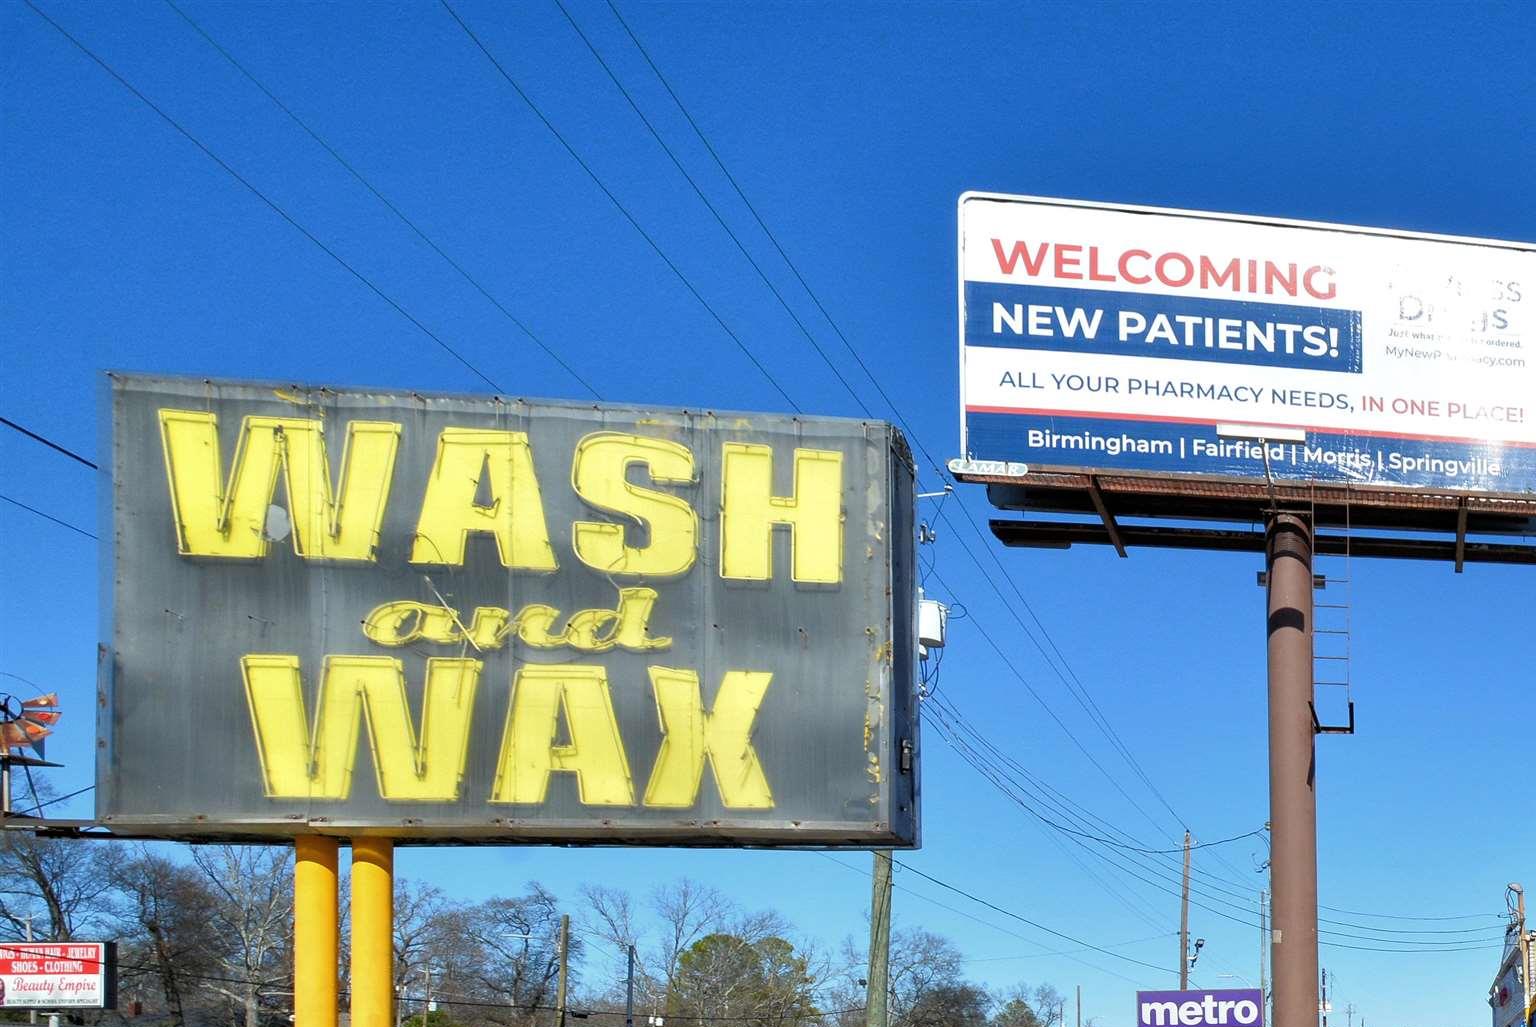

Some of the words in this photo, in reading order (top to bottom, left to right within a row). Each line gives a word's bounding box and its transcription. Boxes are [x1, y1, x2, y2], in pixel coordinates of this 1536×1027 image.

[991, 238, 1337, 300] WELCOMING
[992, 302, 1103, 339] NEW
[1119, 311, 1339, 358] PATIENTS!
[1000, 371, 1044, 389] ALL
[1051, 374, 1119, 394] YOUR
[1128, 378, 1264, 403] PHARMACY
[1271, 388, 1354, 413] NEEDS,
[1361, 395, 1385, 412] IN
[1392, 398, 1440, 417] ONE
[1448, 402, 1525, 423] PLACE!
[1028, 429, 1173, 455] Birmingham
[1304, 446, 1371, 468] Morris
[1388, 451, 1500, 477] Springville
[158, 407, 846, 585] WASH
[360, 586, 674, 655] and
[241, 653, 776, 809] WAX
[11, 960, 38, 974] SHOES
[45, 960, 83, 973] CLOTHING
[12, 976, 55, 996] Beauty
[58, 977, 96, 995] Empire
[1141, 994, 1259, 1026] metro
